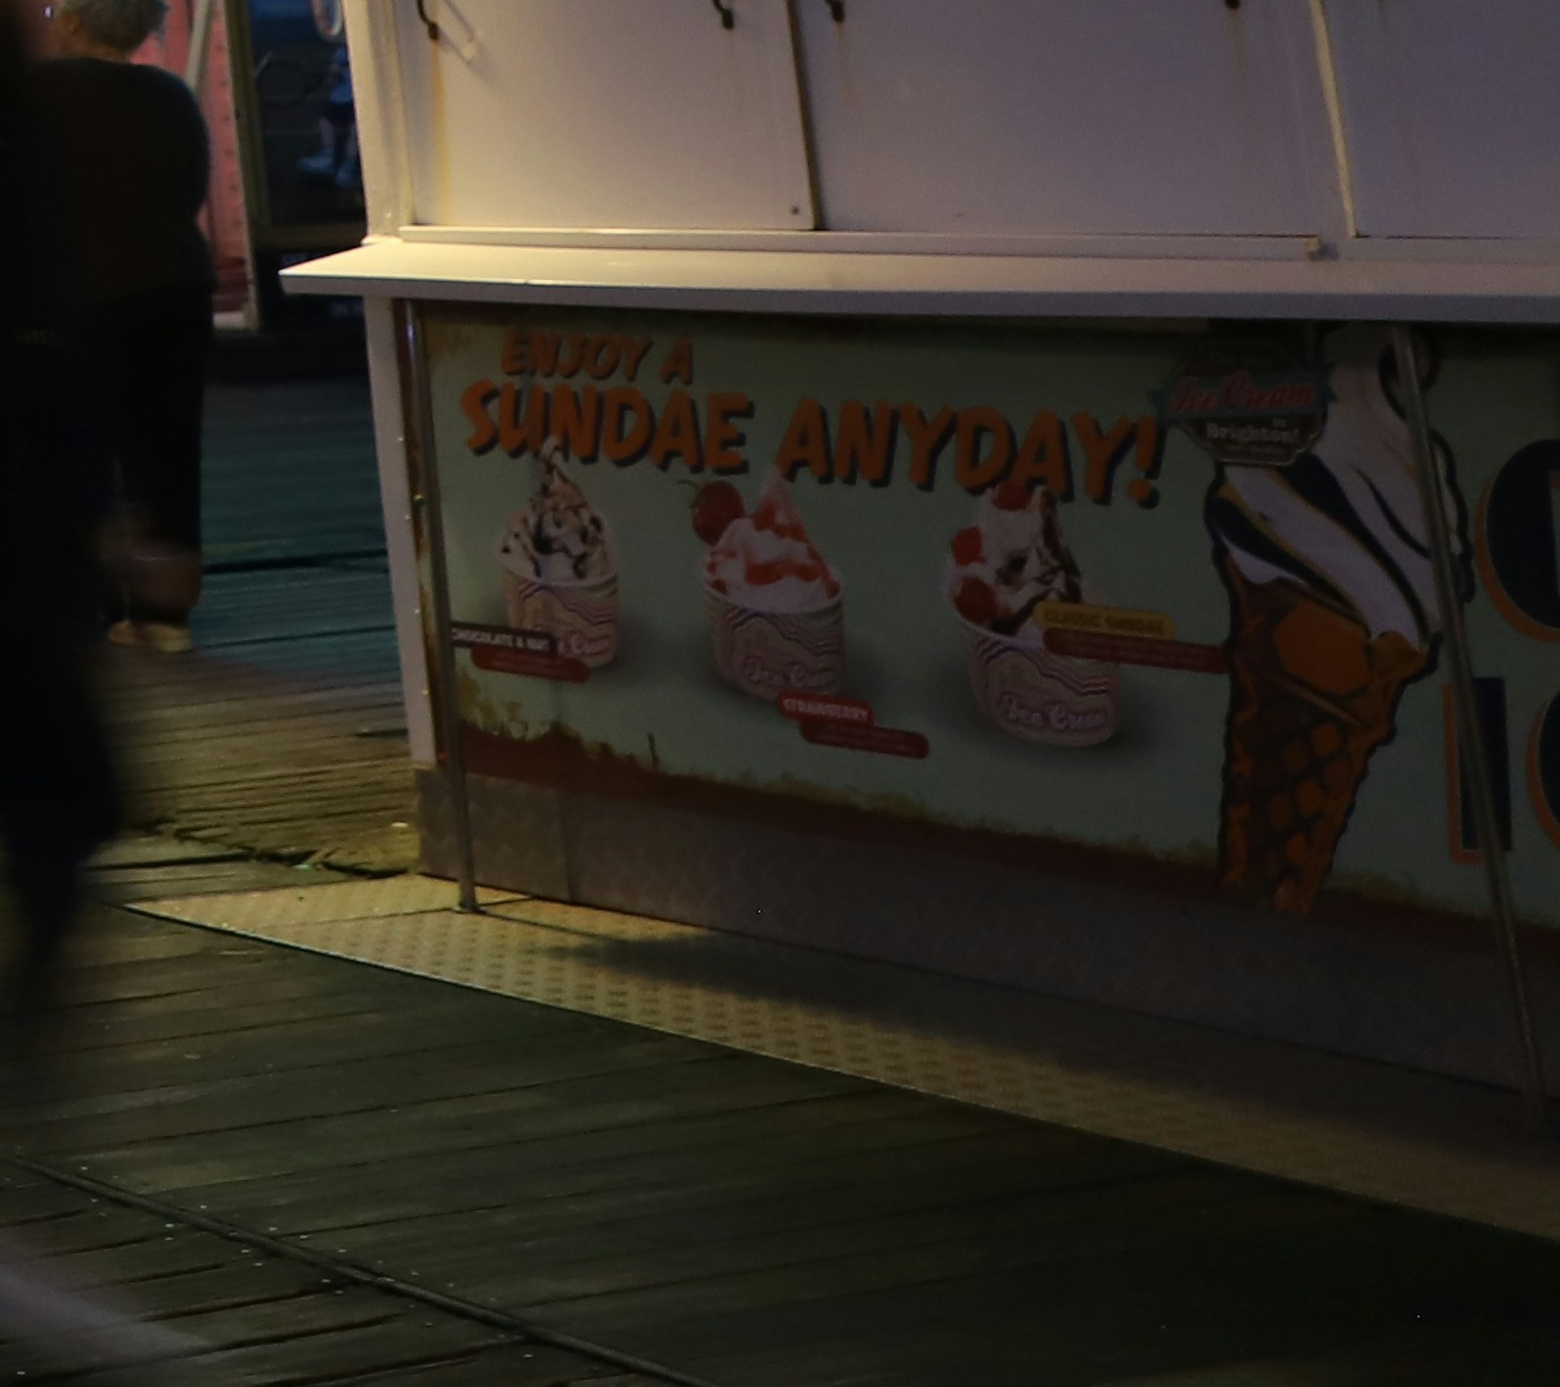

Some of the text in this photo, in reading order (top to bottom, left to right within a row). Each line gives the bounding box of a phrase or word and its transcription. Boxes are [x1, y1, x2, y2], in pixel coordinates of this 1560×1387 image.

[501, 330, 694, 386] ENJOY A
[461, 380, 1167, 509] SUNDAE ANYDAY!
